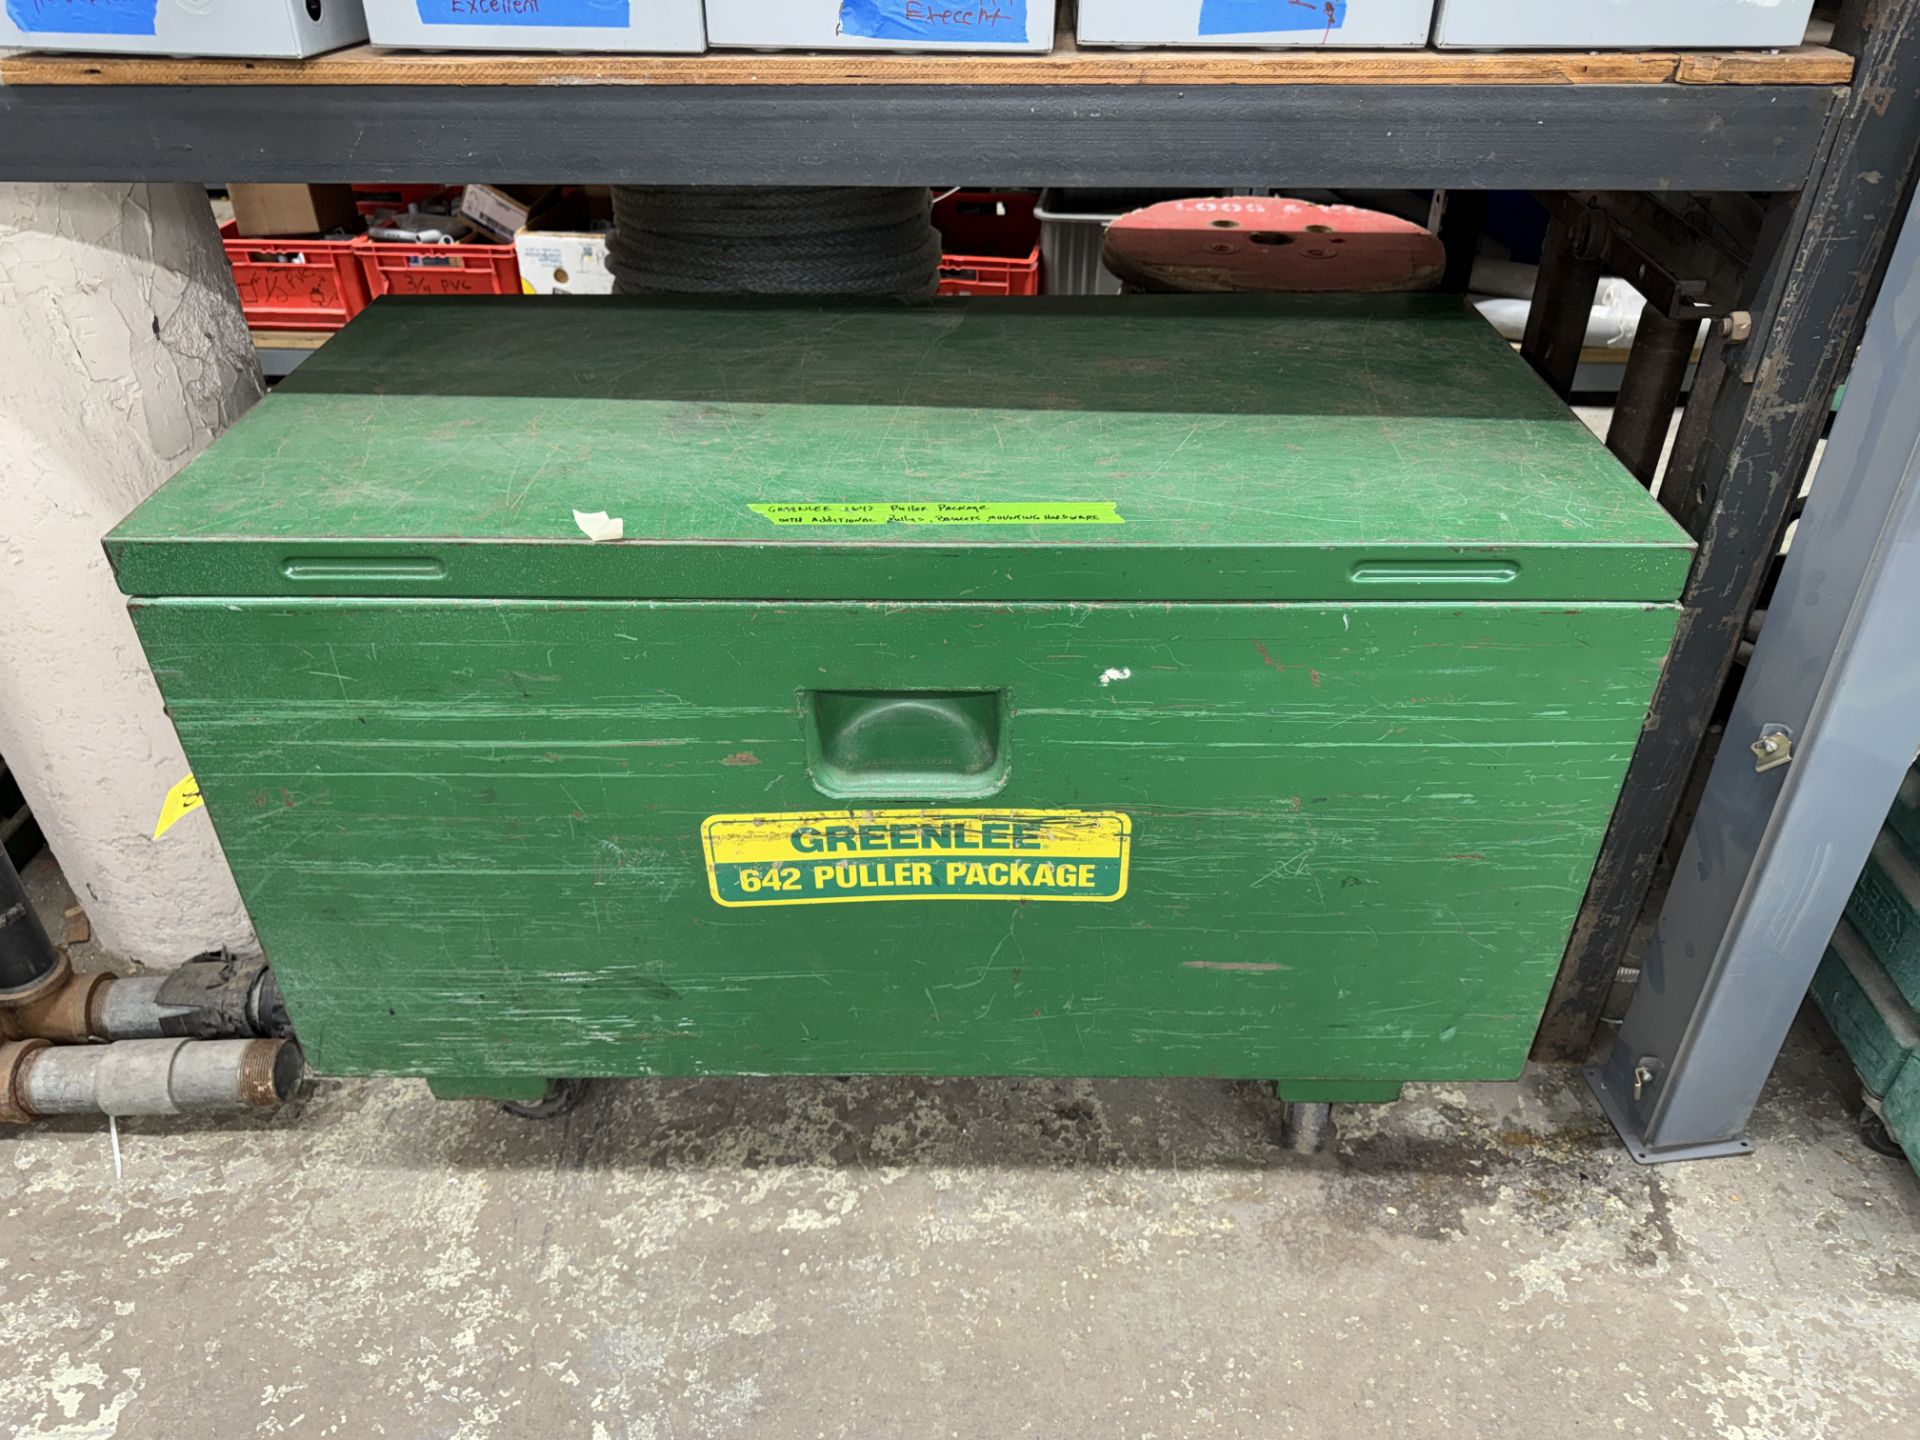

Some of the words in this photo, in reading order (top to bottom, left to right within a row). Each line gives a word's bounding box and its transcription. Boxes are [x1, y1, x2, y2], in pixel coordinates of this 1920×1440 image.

[440, 279, 472, 294] PVC
[790, 823, 1041, 853] GREENLEE
[739, 867, 803, 892] 642
[813, 862, 933, 889] PULLER
[946, 862, 1096, 888] PACKAGE
